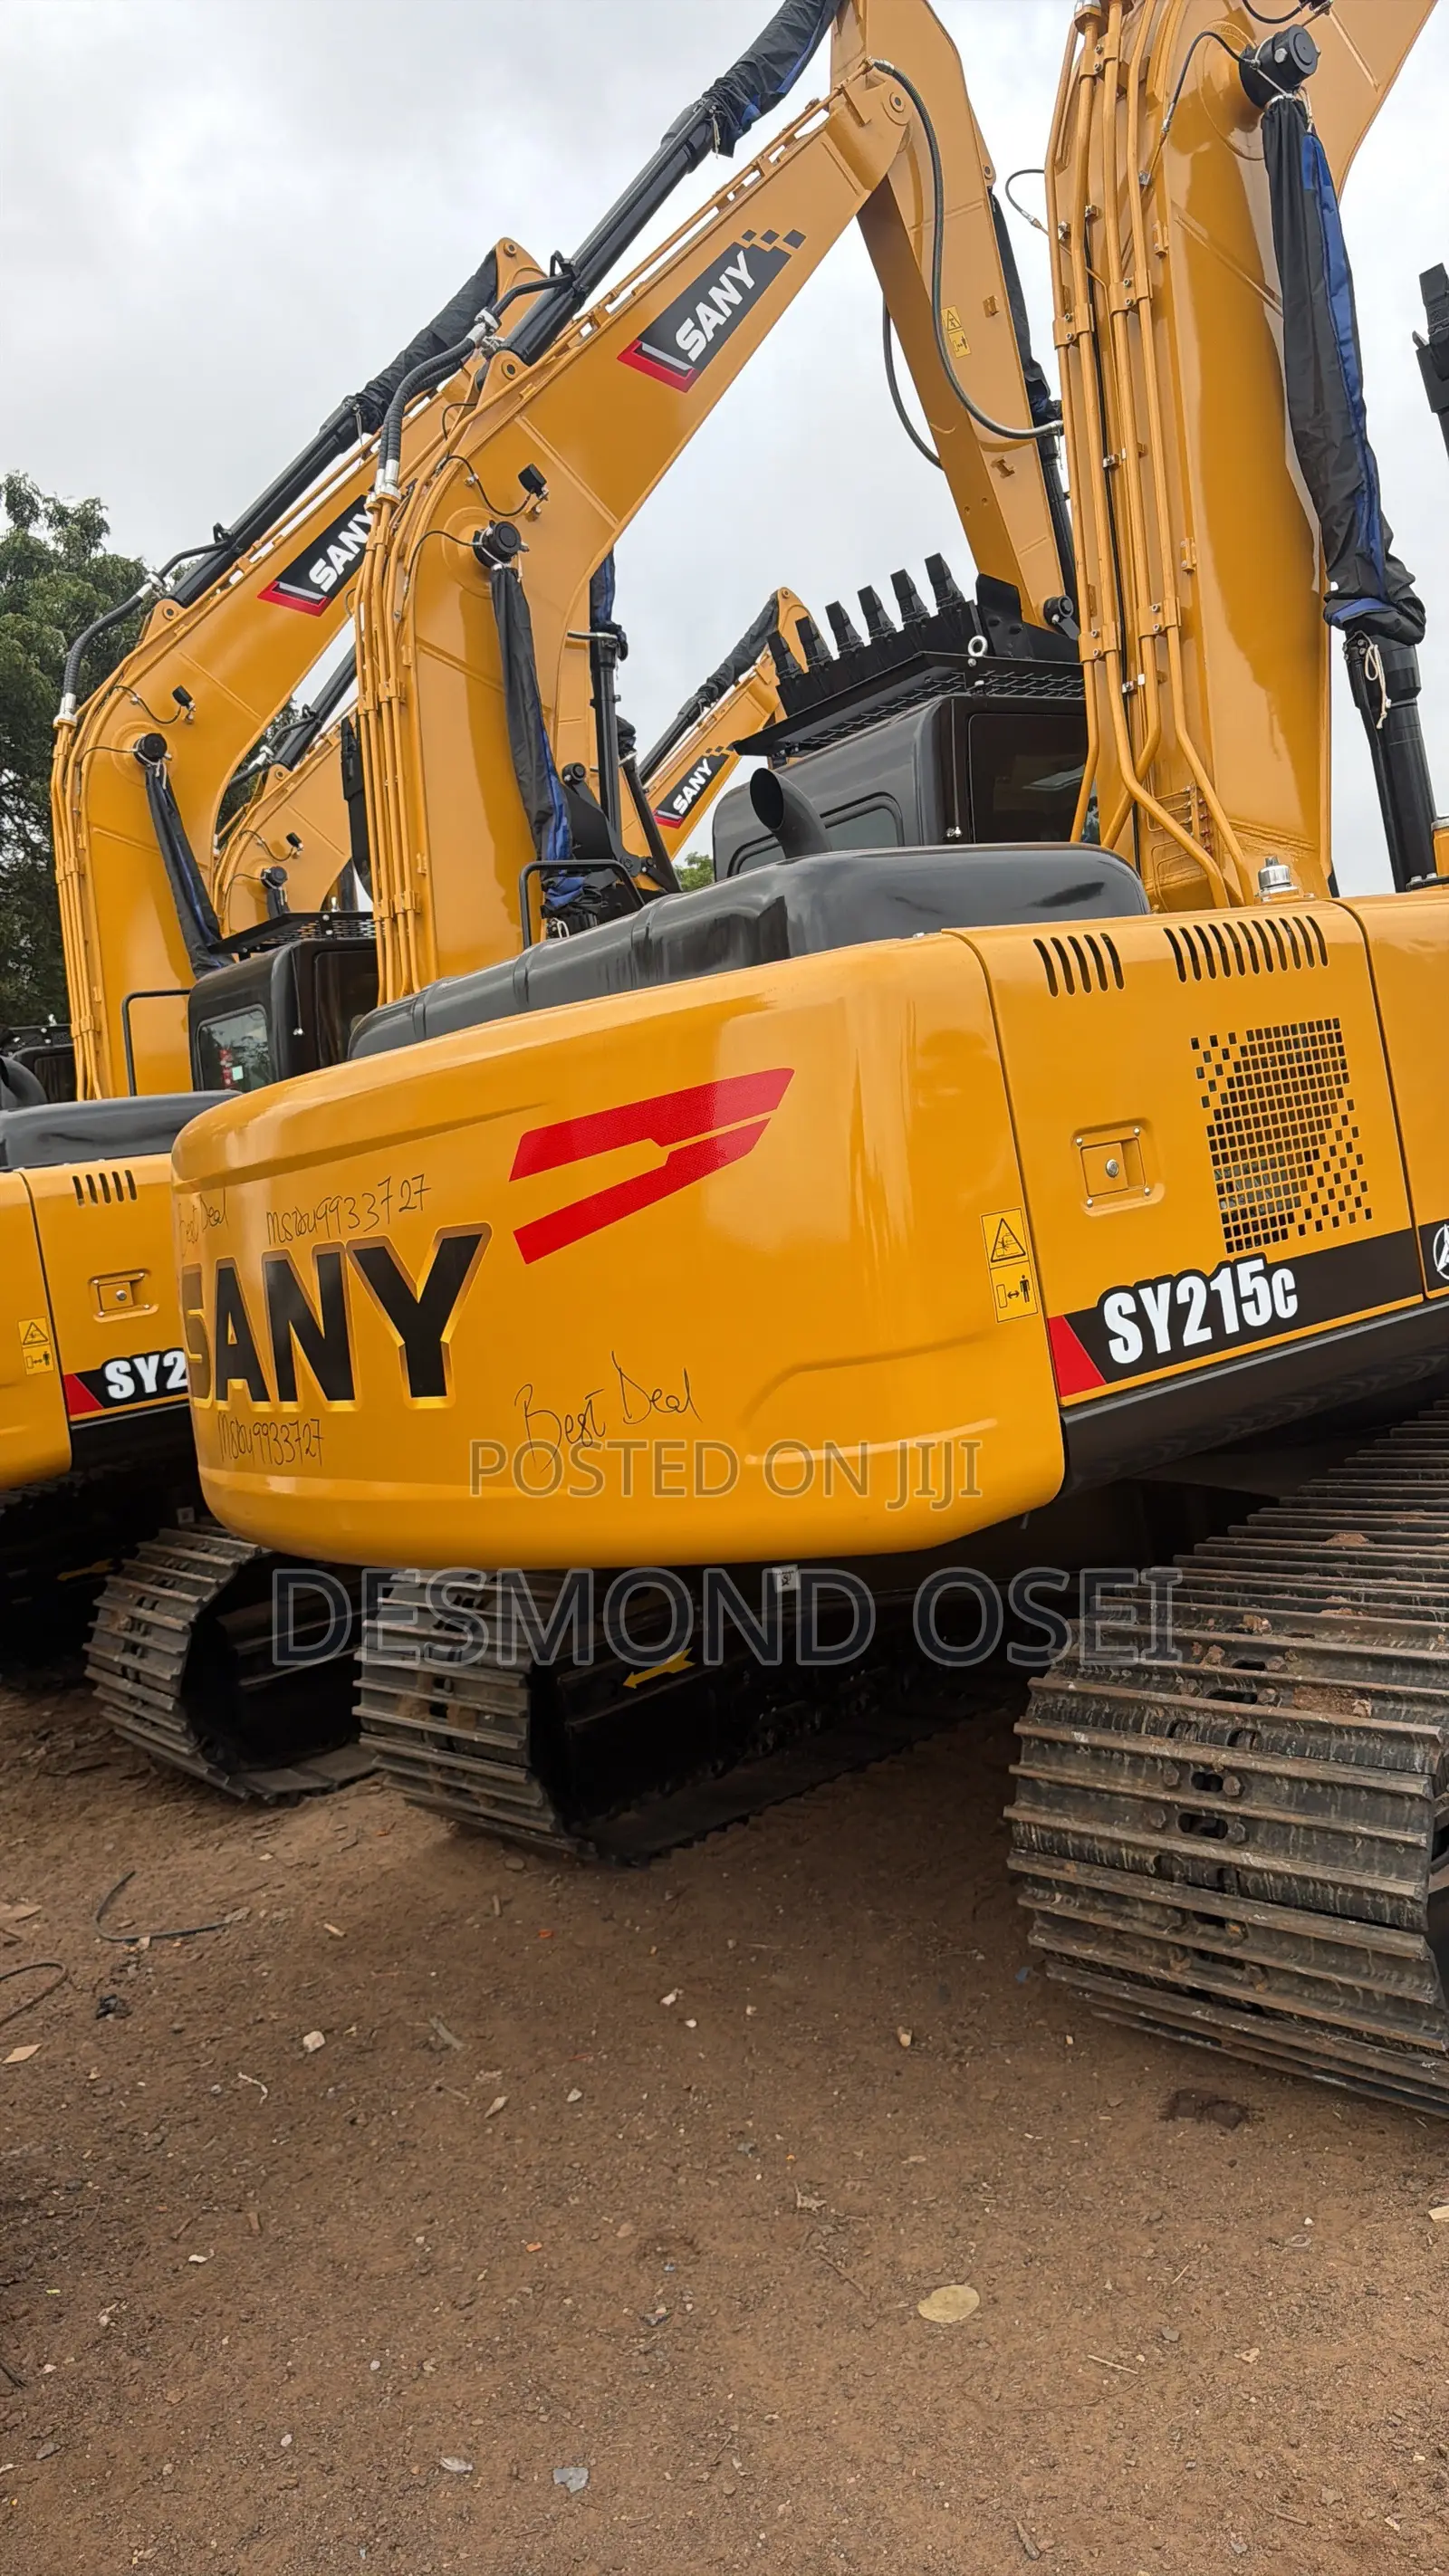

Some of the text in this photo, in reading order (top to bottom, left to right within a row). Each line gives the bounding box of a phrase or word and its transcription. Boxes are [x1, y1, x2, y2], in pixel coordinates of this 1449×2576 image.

[676, 250, 755, 362] SANY
[673, 758, 712, 815] SANY
[514, 1350, 704, 1474] Best Deal
